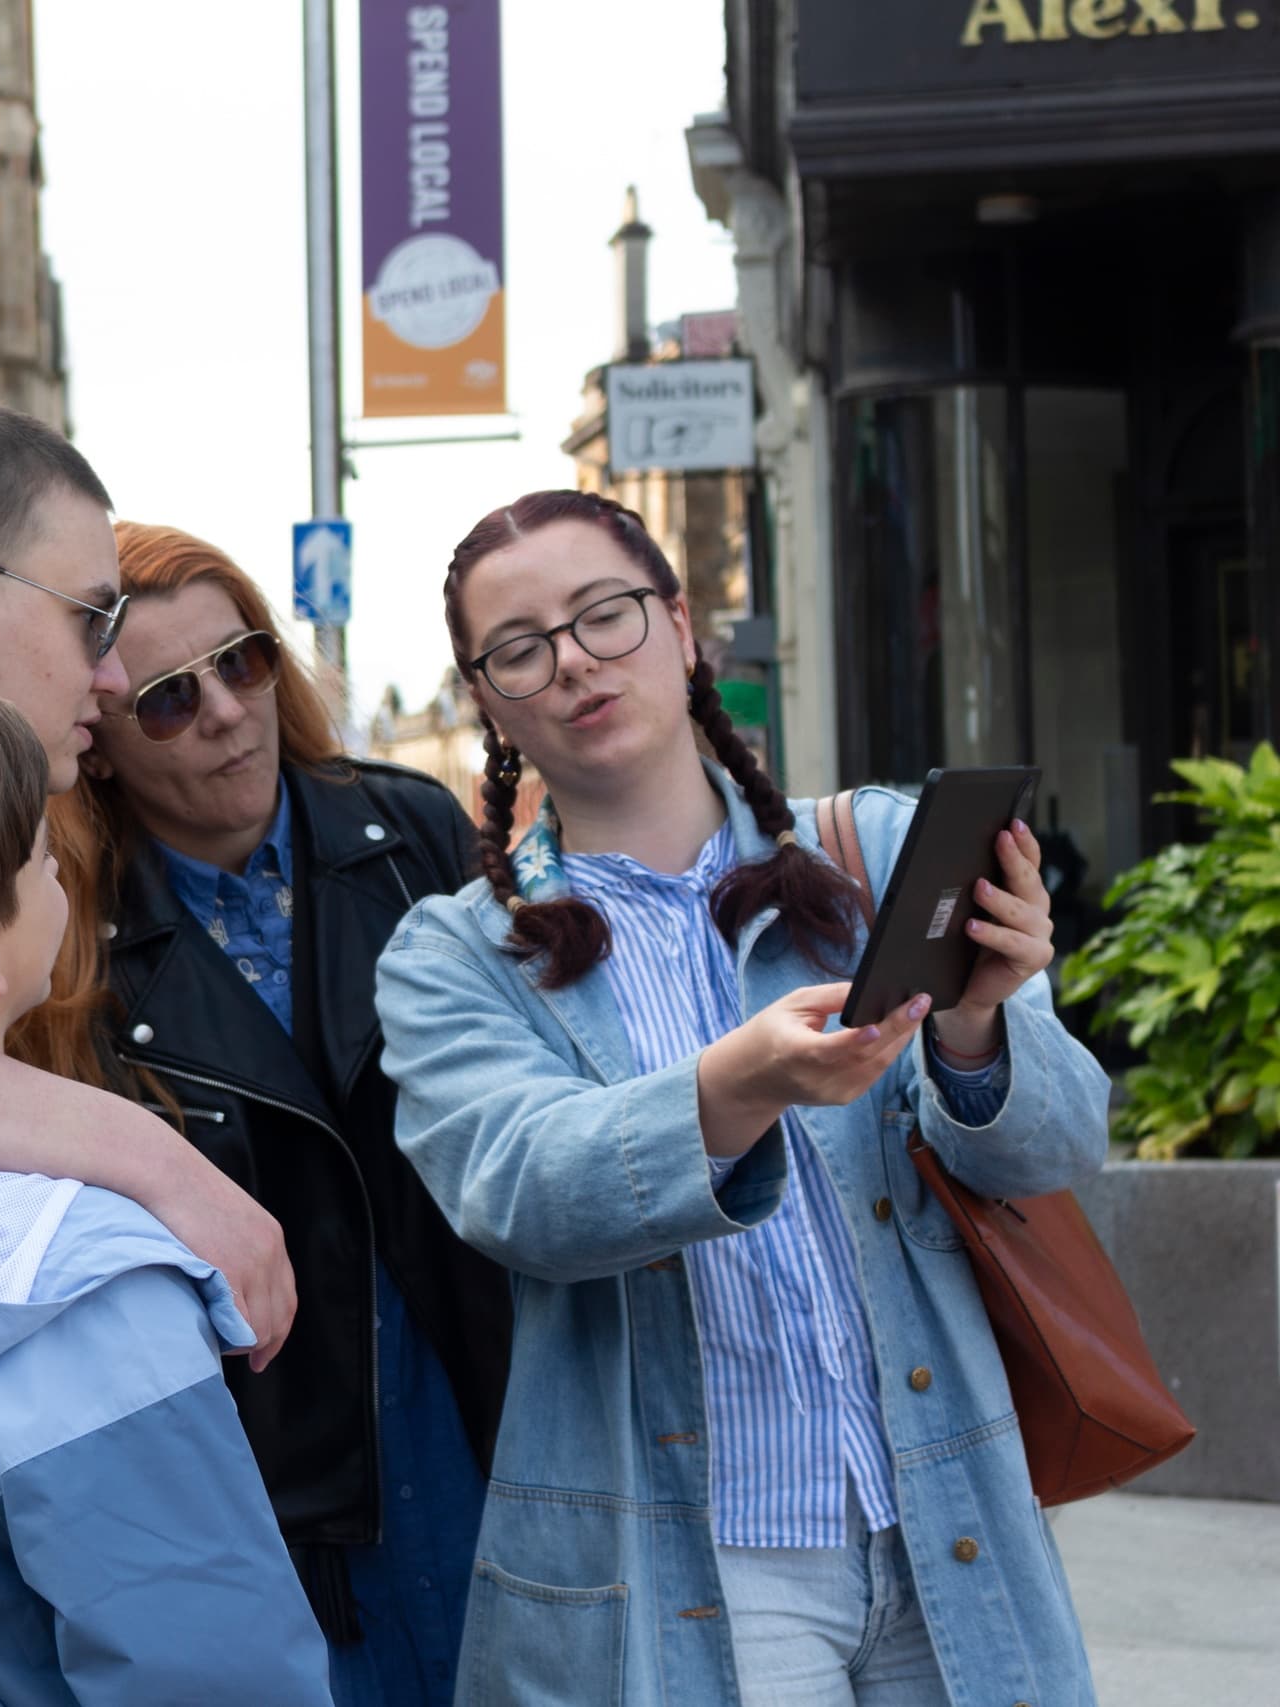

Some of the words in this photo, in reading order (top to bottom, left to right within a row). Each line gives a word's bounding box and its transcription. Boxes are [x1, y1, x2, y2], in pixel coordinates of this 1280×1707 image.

[407, 5, 450, 117] SPEND
[408, 121, 451, 228] LOCAL
[617, 378, 743, 400] Solicitors
